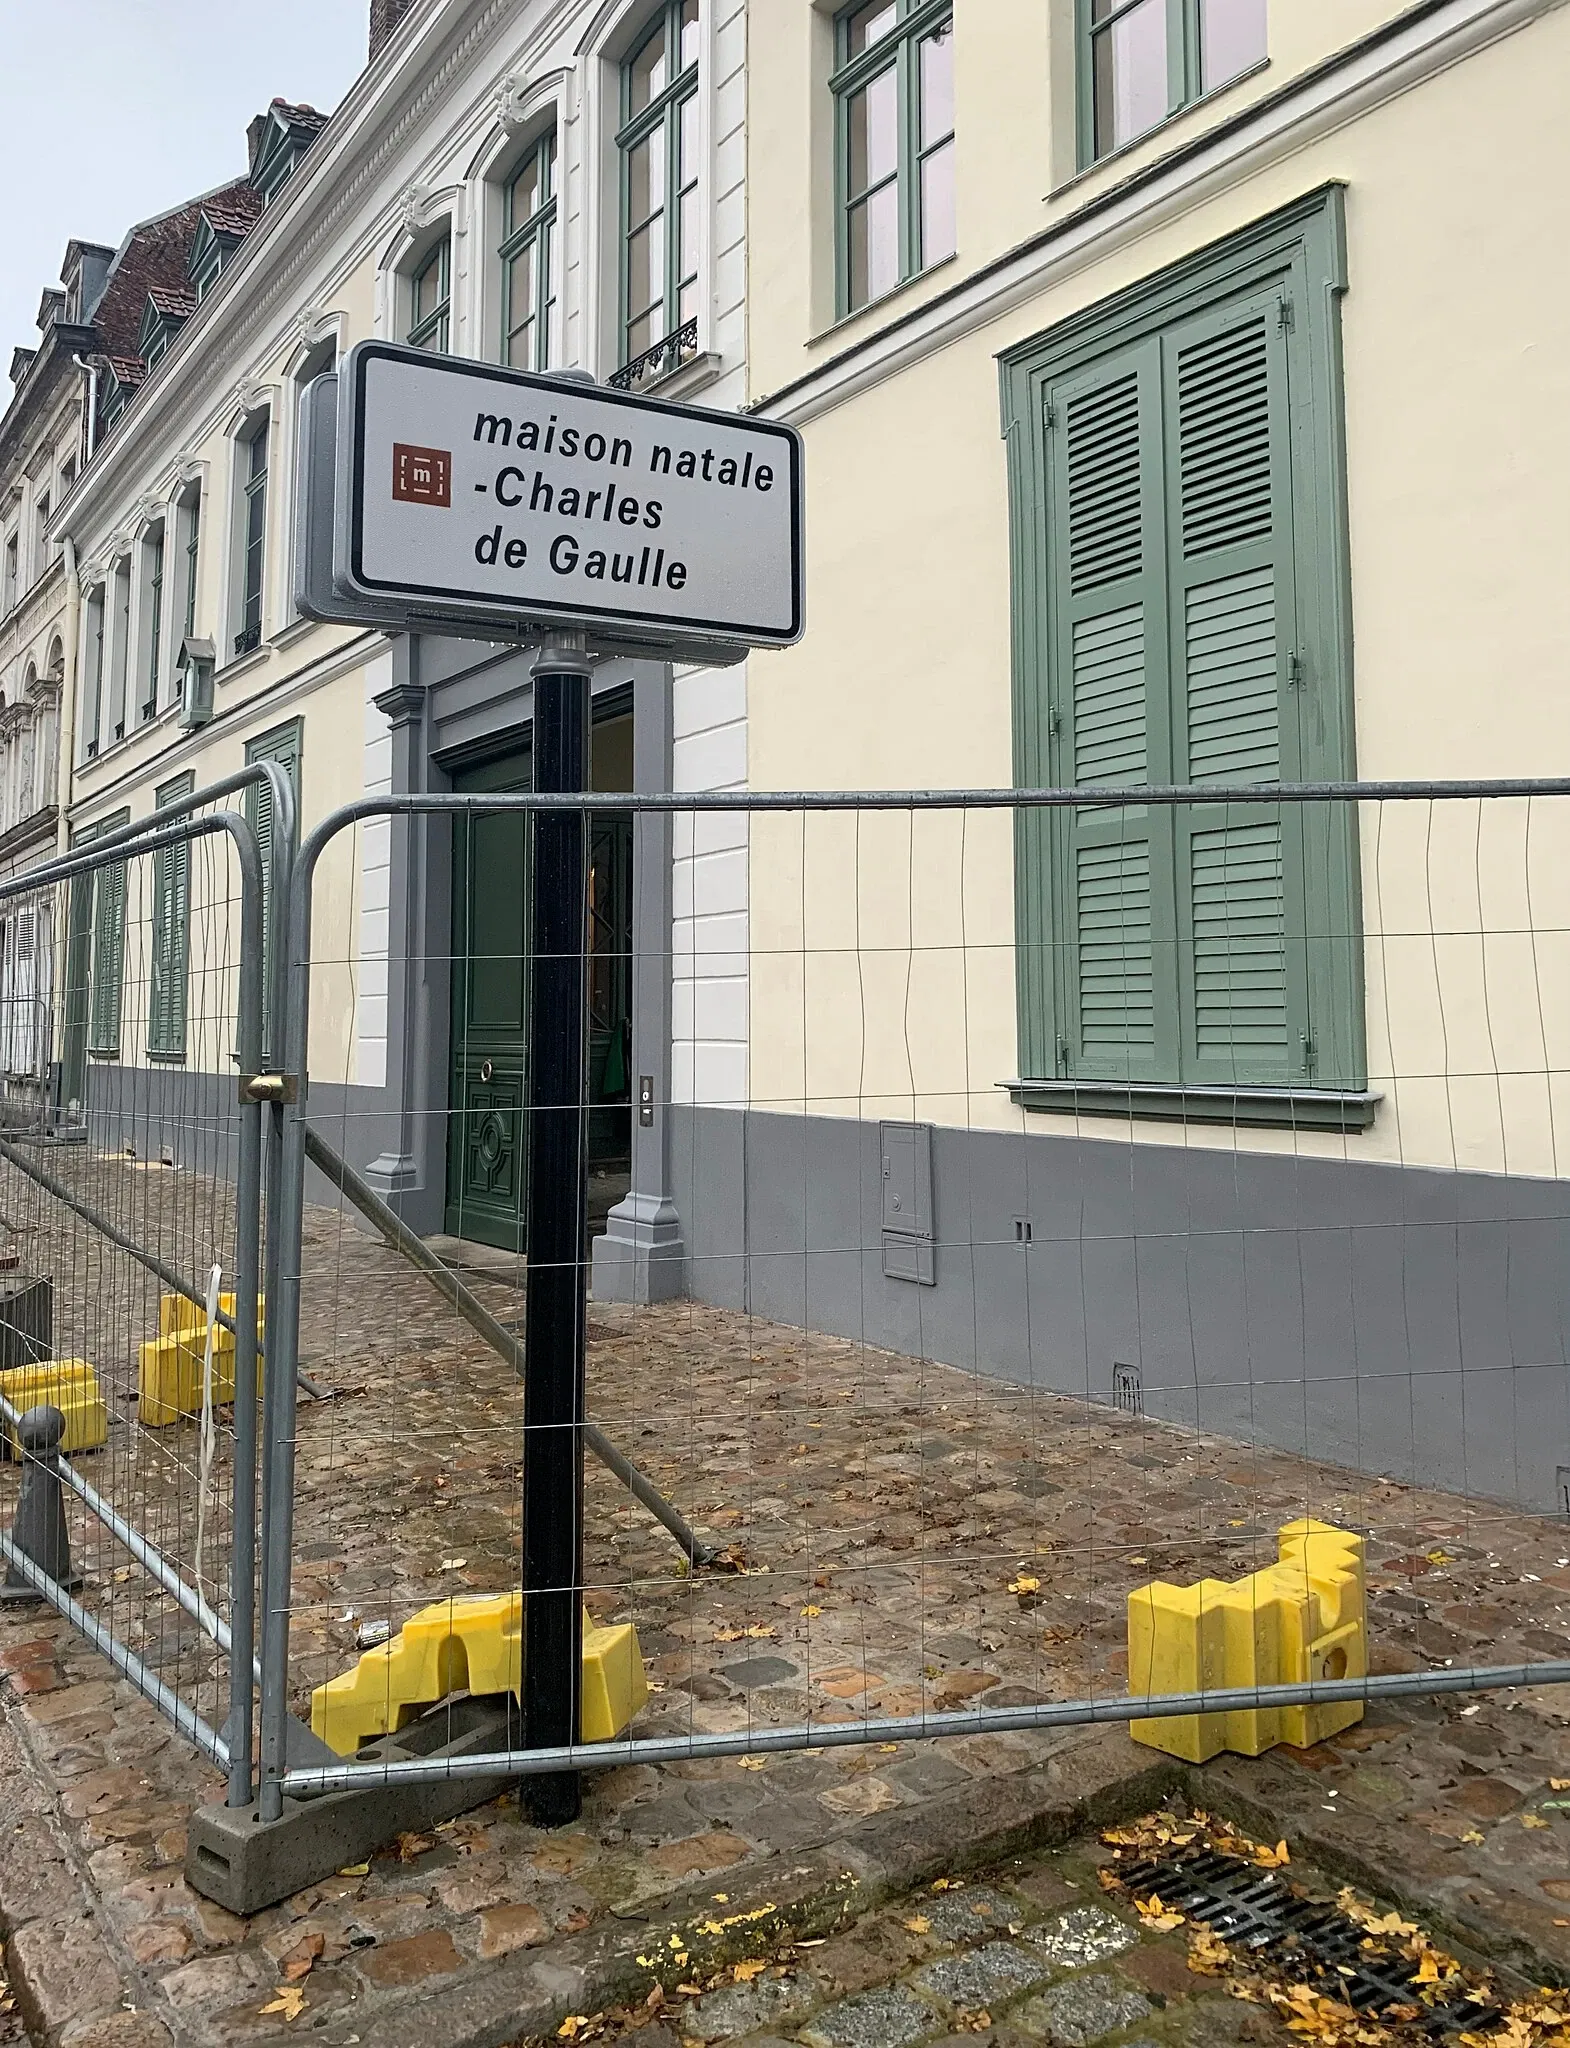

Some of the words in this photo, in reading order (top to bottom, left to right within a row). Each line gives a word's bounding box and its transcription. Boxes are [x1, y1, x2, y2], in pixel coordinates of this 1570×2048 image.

[413, 467, 431, 484] m
[473, 412, 632, 467] maison
[649, 445, 774, 492] natale
[474, 466, 663, 529] -Charles
[474, 524, 528, 569] de
[549, 534, 687, 590] Gaulle
